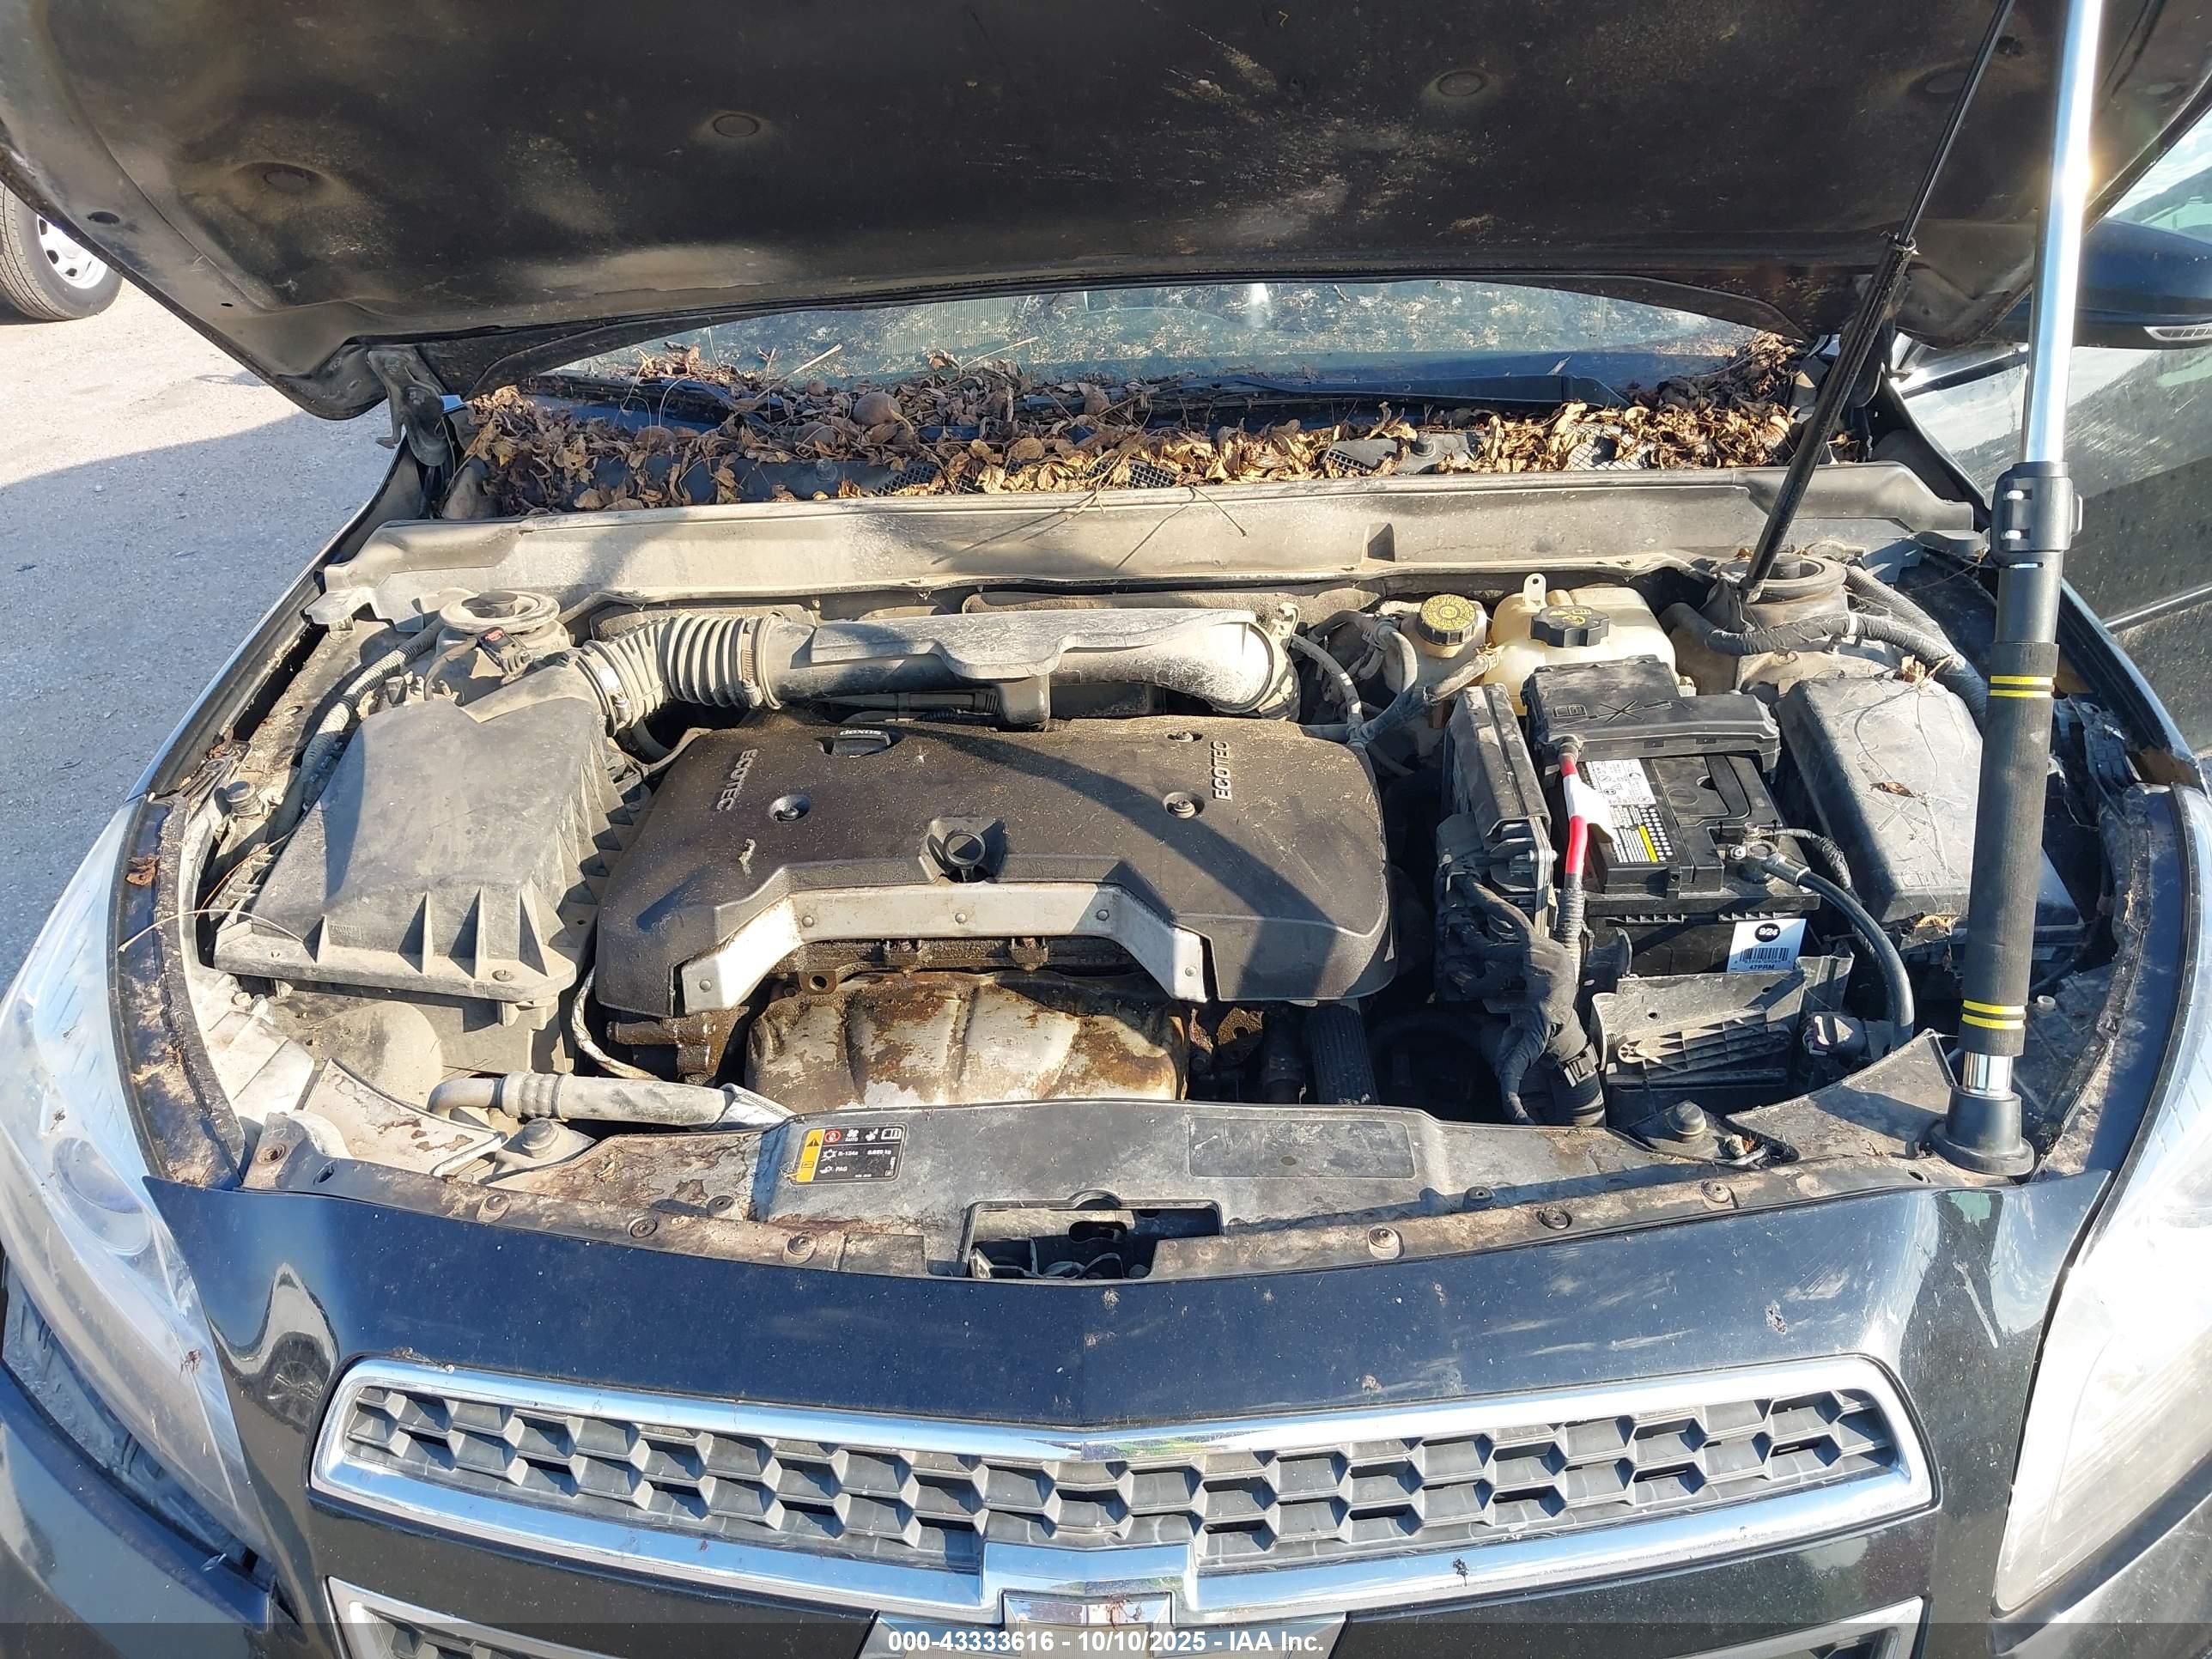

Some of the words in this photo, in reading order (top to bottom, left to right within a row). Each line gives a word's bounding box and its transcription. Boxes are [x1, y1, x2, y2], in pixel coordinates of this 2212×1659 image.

[716, 748, 758, 811] ECOTEC
[1212, 740, 1232, 801] ECOTEC
[1758, 927, 1779, 937] 9/24
